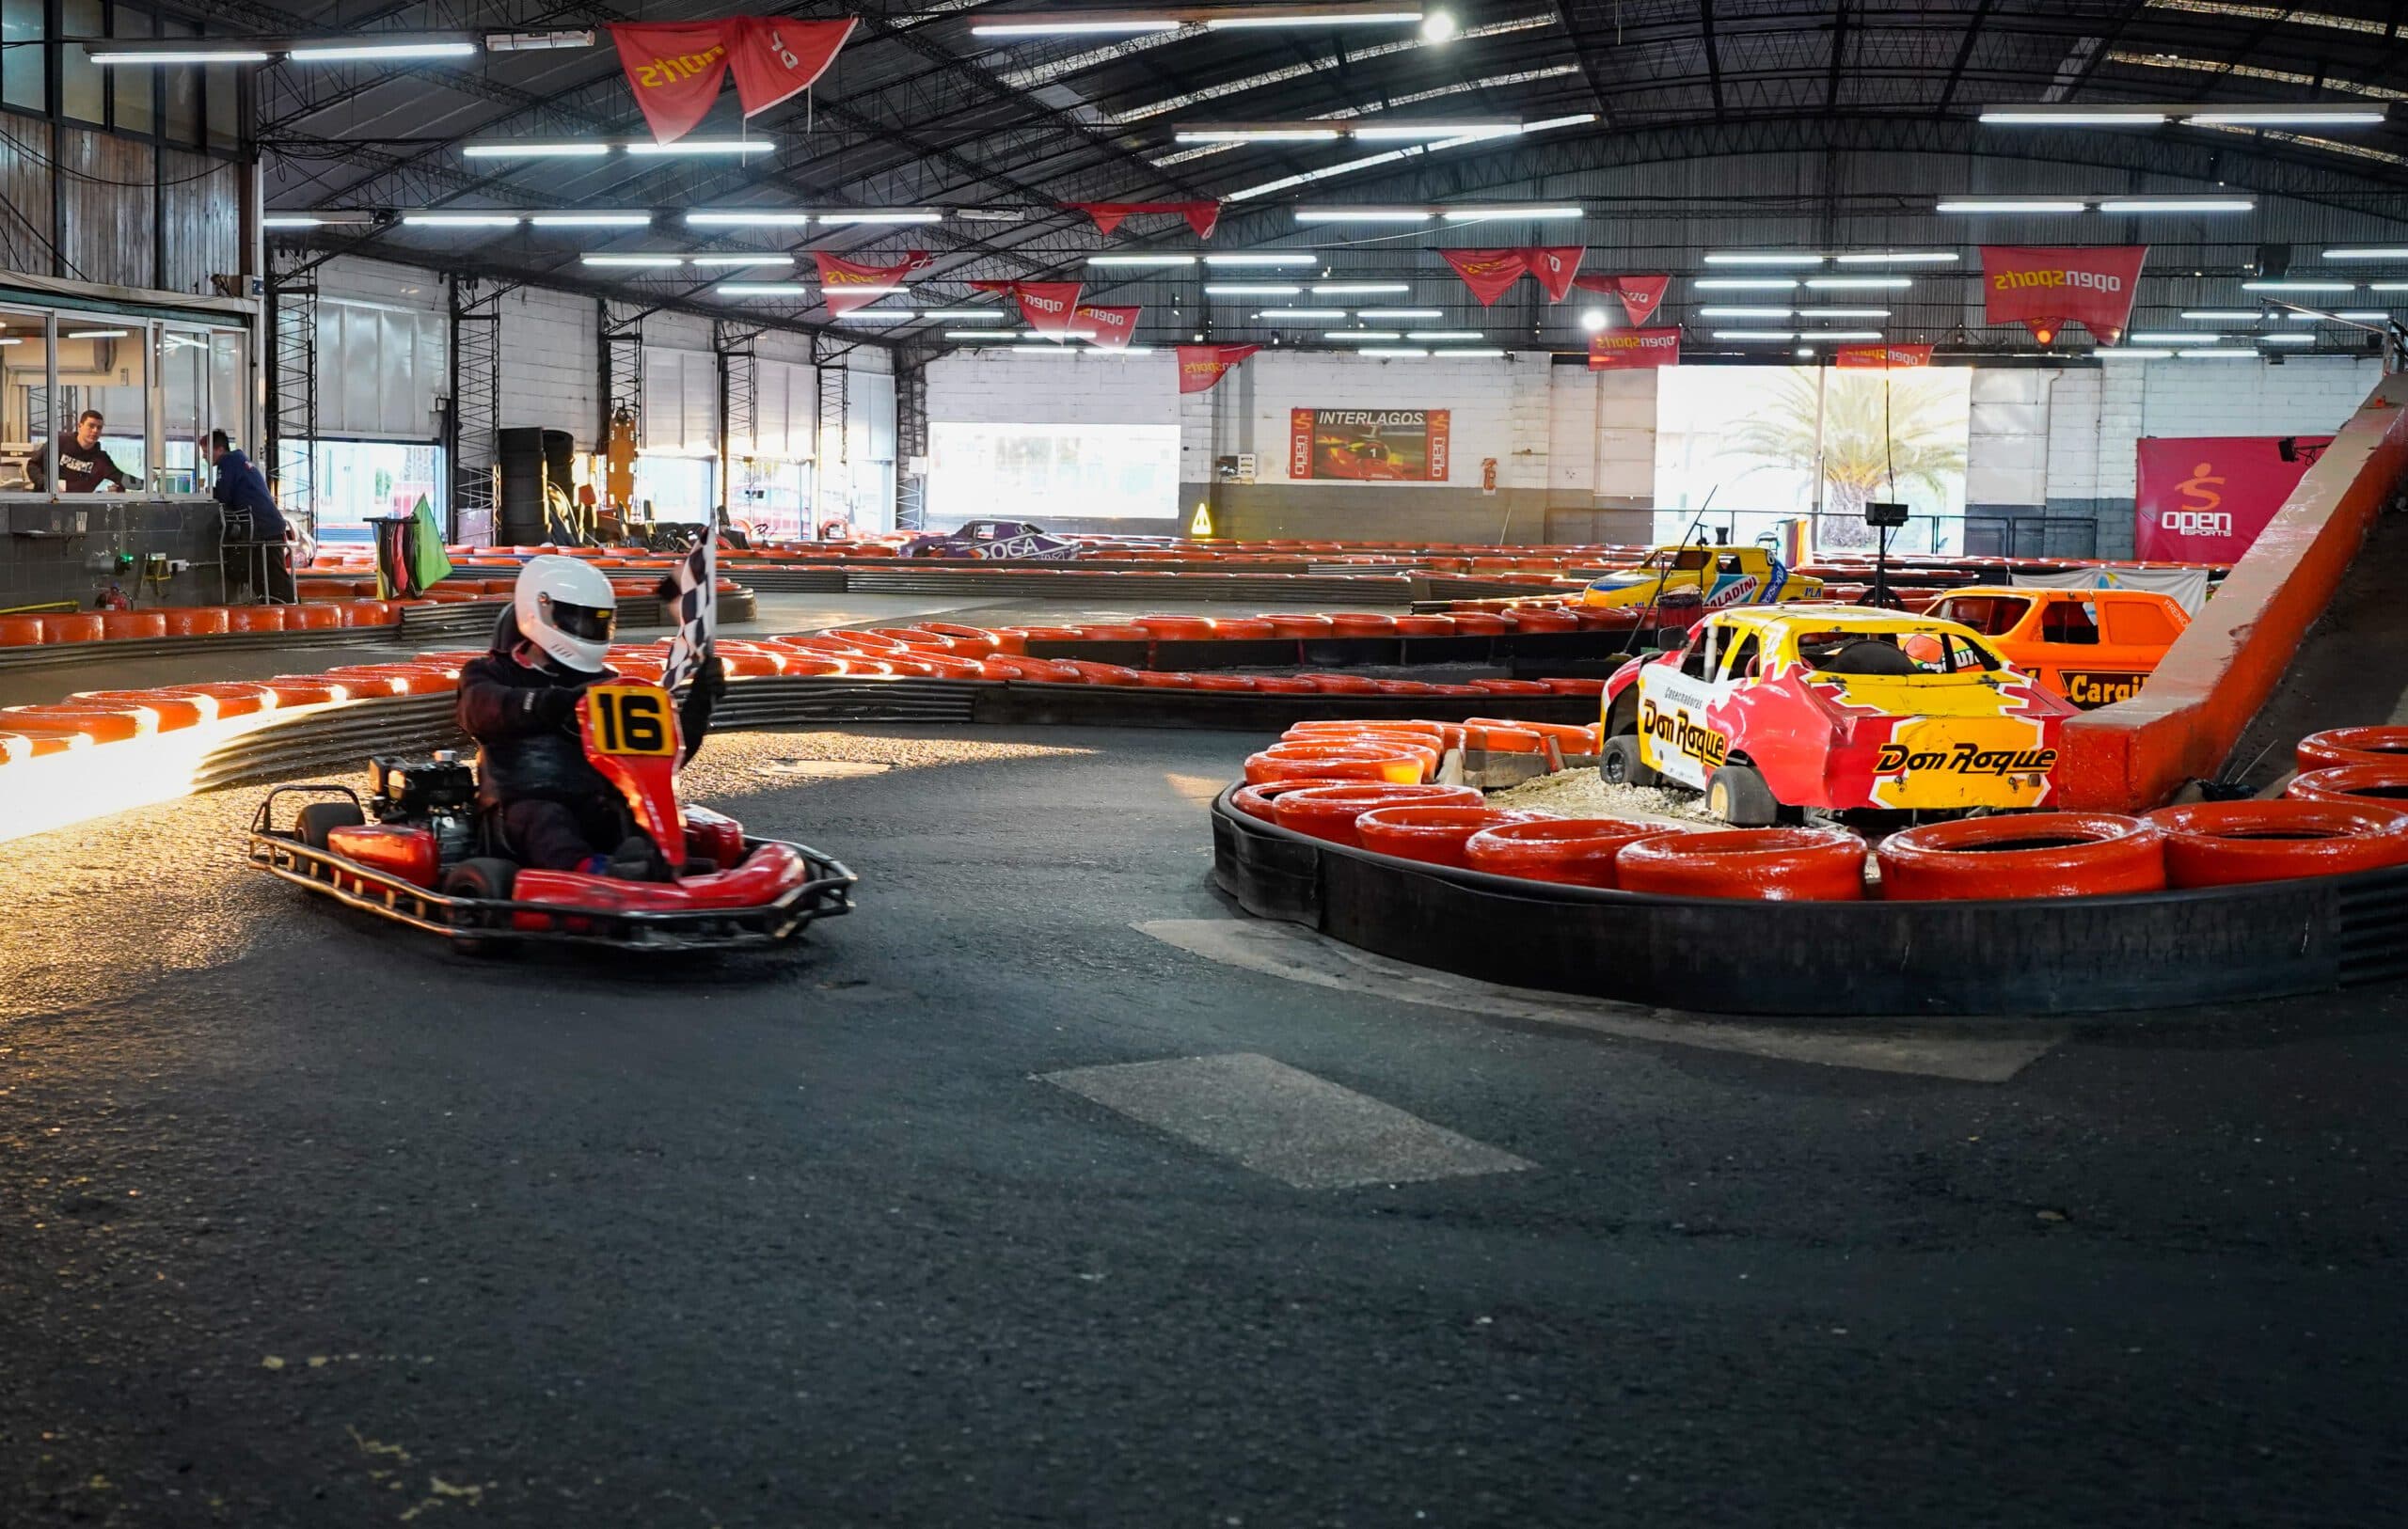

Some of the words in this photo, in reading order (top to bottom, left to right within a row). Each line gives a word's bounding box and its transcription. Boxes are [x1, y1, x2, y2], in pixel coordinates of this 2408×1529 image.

[1319, 411, 1425, 425] INTERLAGOS
[2162, 512, 2232, 535] open
[990, 537, 1040, 560] OCA
[1703, 575, 1757, 607] ALADINI
[2070, 674, 2148, 702] Cargi
[597, 693, 662, 751] 16
[1644, 699, 1674, 743] Don
[1676, 708, 1725, 767] Roque
[1875, 744, 1948, 772] Don
[1947, 743, 2057, 776] Roque
